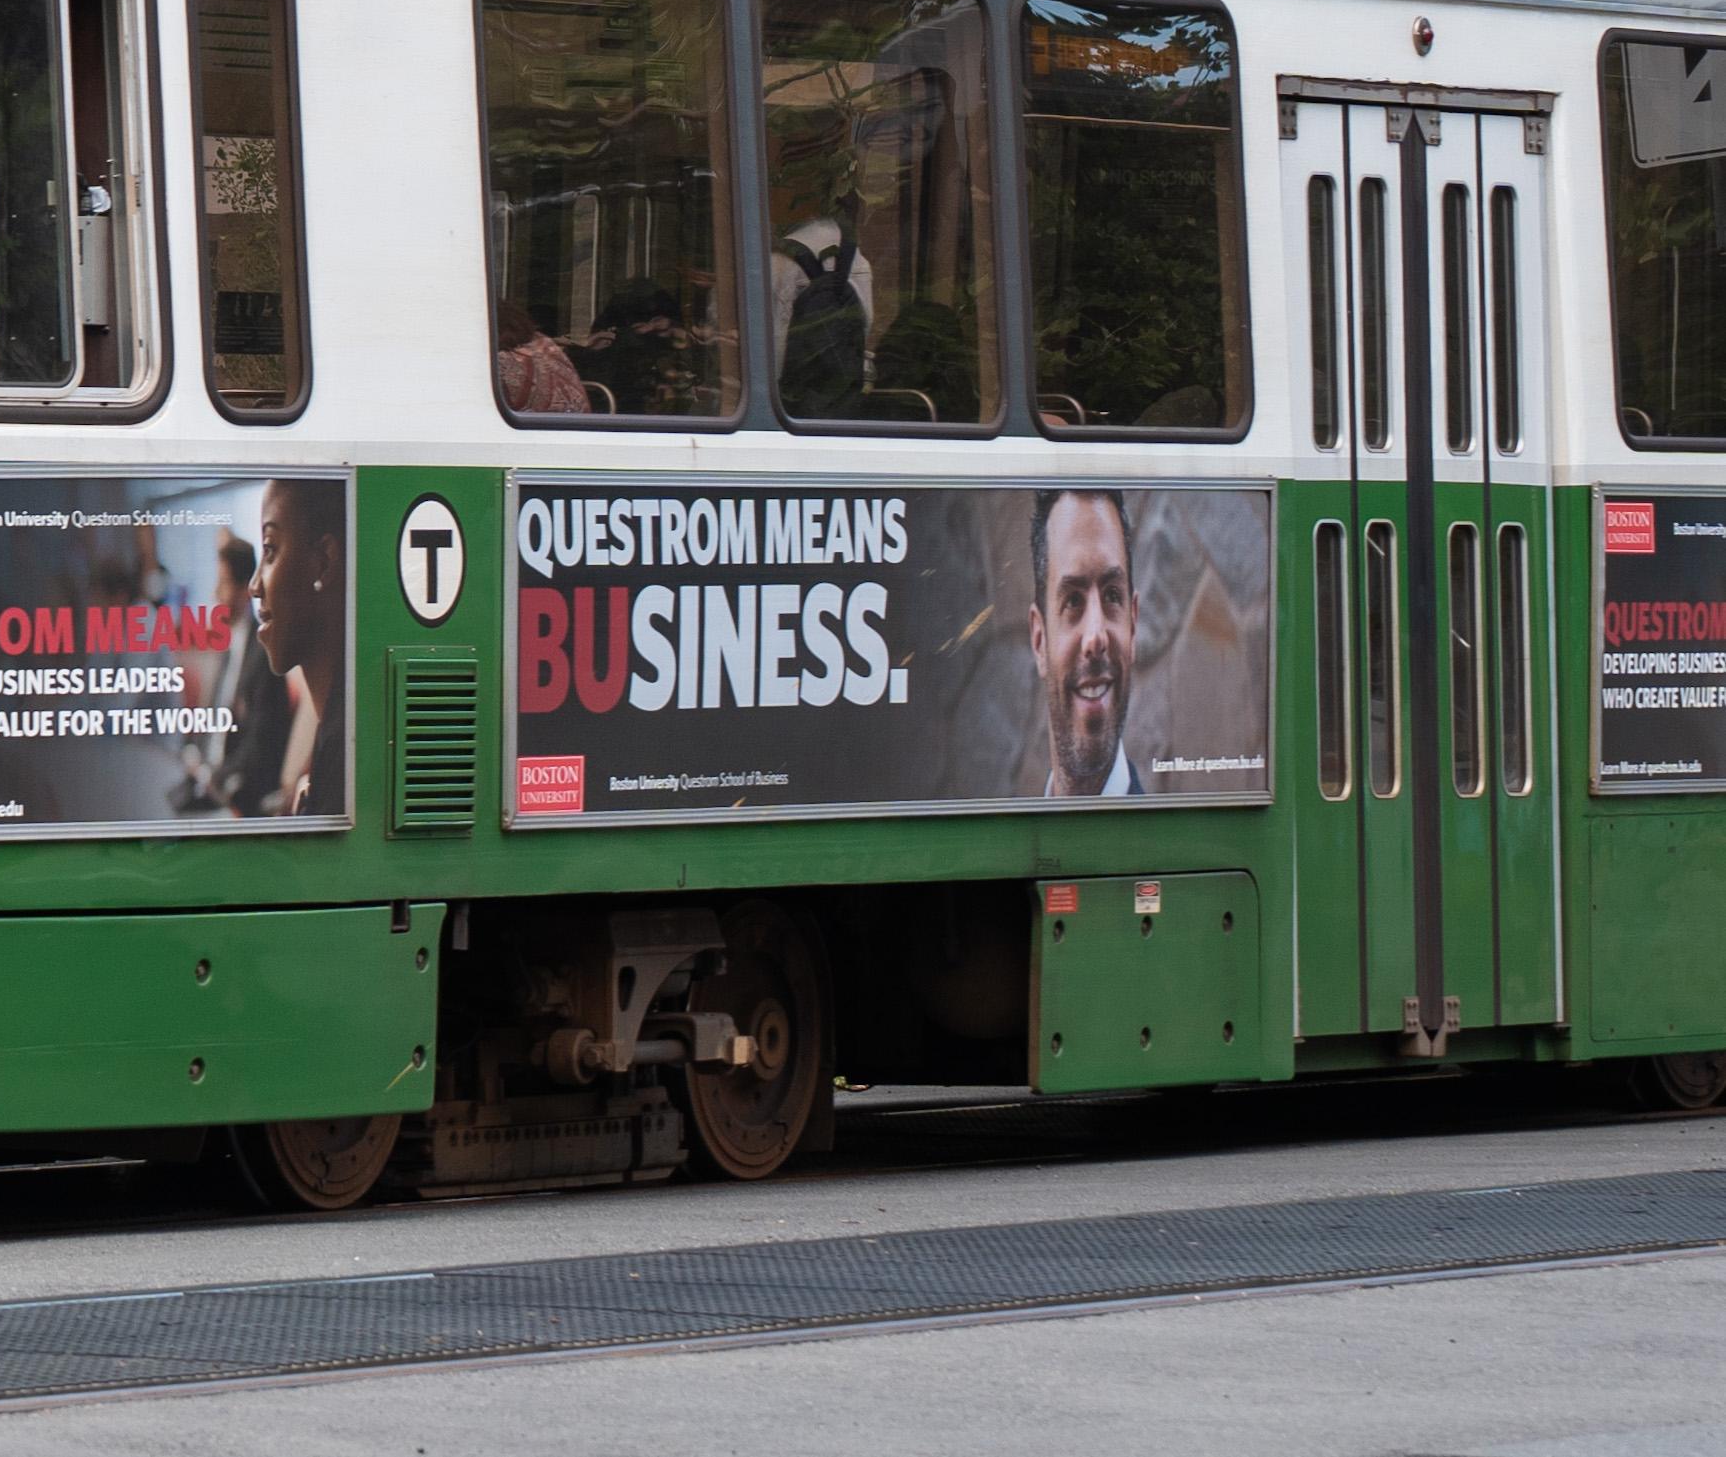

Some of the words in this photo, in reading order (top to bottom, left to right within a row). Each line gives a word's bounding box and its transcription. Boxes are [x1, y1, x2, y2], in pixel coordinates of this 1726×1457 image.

[4, 510, 70, 529] University
[72, 510, 131, 528] Questrom
[133, 510, 170, 526] School
[172, 510, 185, 526] of
[186, 510, 233, 526] Business
[1607, 511, 1650, 527] BOSTON
[518, 499, 759, 579] QUESTROM
[765, 498, 907, 565] MEANS
[409, 529, 453, 604] T
[85, 604, 233, 654] MEANS
[1605, 601, 1726, 648] QUESTROM
[518, 581, 909, 713] BUSINESS.
[1603, 653, 1677, 674] DEVELOPING
[1678, 652, 1726, 673] BUSINES
[88, 667, 185, 694] LEADERS
[1602, 687, 1634, 708] WHO
[1635, 687, 1679, 708] CREATE
[1680, 687, 1717, 708] VALUE
[58, 709, 105, 736] FOR
[108, 708, 152, 735] THE
[155, 707, 238, 734] WORLD.
[522, 765, 579, 785] BOSTON
[1152, 757, 1174, 772] Learn
[1174, 757, 1195, 771] More
[1196, 757, 1204, 771] at
[609, 776, 638, 791] Boston
[639, 774, 679, 792] University
[680, 773, 718, 791] Questrom
[720, 771, 745, 788] School
[746, 771, 754, 786] of
[755, 770, 789, 786] Business
[521, 790, 579, 805] UNIVERSITY
